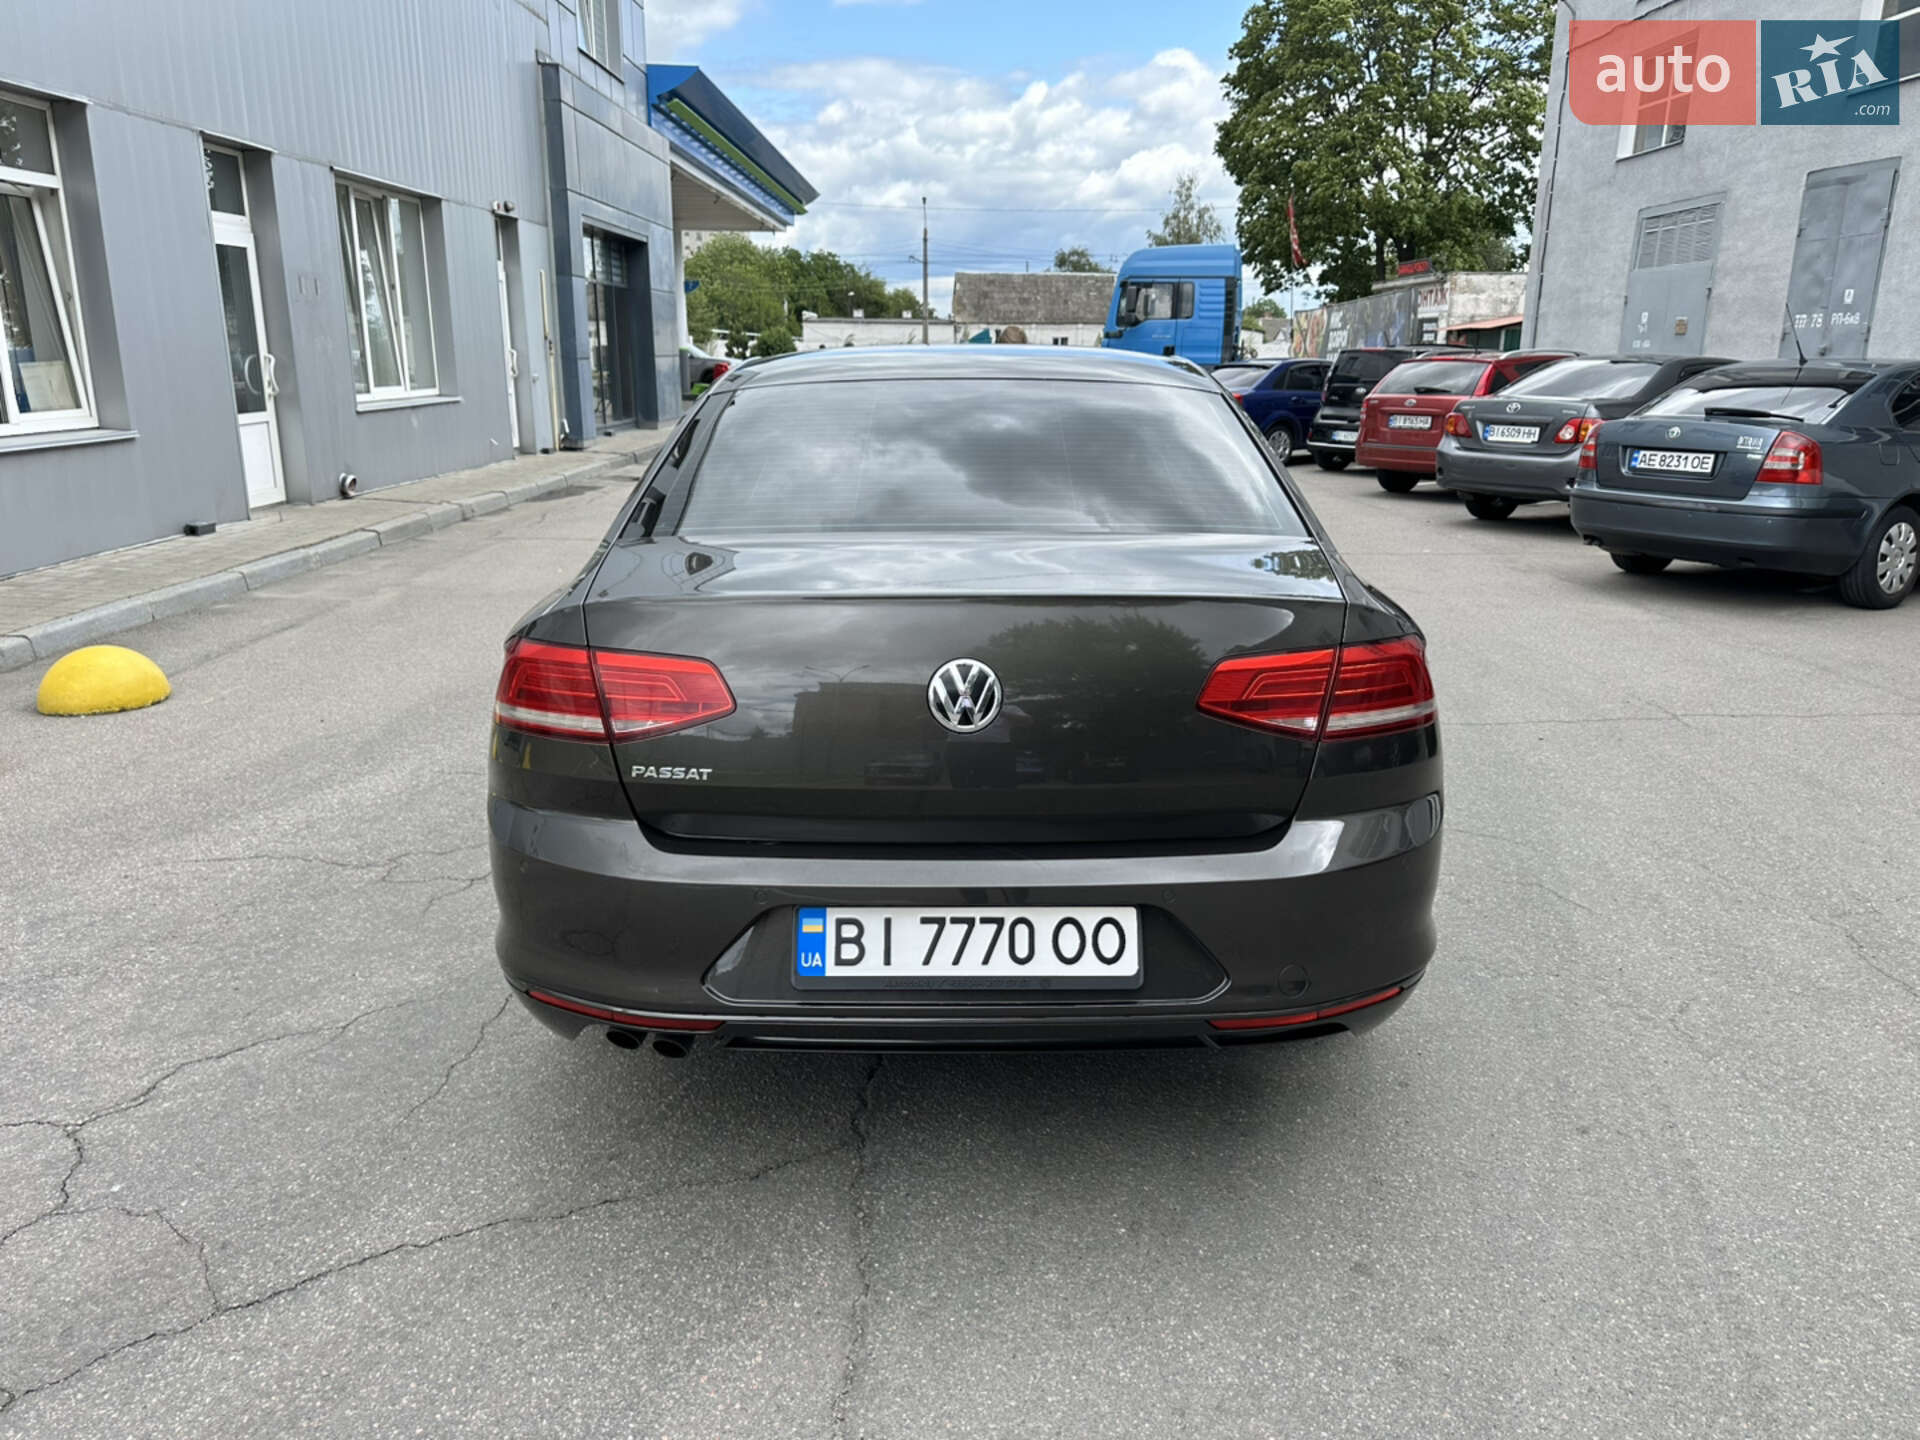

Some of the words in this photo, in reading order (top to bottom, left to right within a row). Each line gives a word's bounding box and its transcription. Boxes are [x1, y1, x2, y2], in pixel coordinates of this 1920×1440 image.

[1489, 425, 1500, 437] BI
[1501, 427, 1522, 438] 6509
[1523, 430, 1537, 439] HH
[1638, 452, 1658, 467] AE
[1658, 453, 1689, 469] 8231
[1691, 456, 1712, 471] OE
[631, 765, 713, 780] PASSAT
[834, 916, 893, 966] BI
[919, 916, 1036, 966] 7770
[1051, 916, 1127, 966] OO
[801, 952, 823, 968] UA
